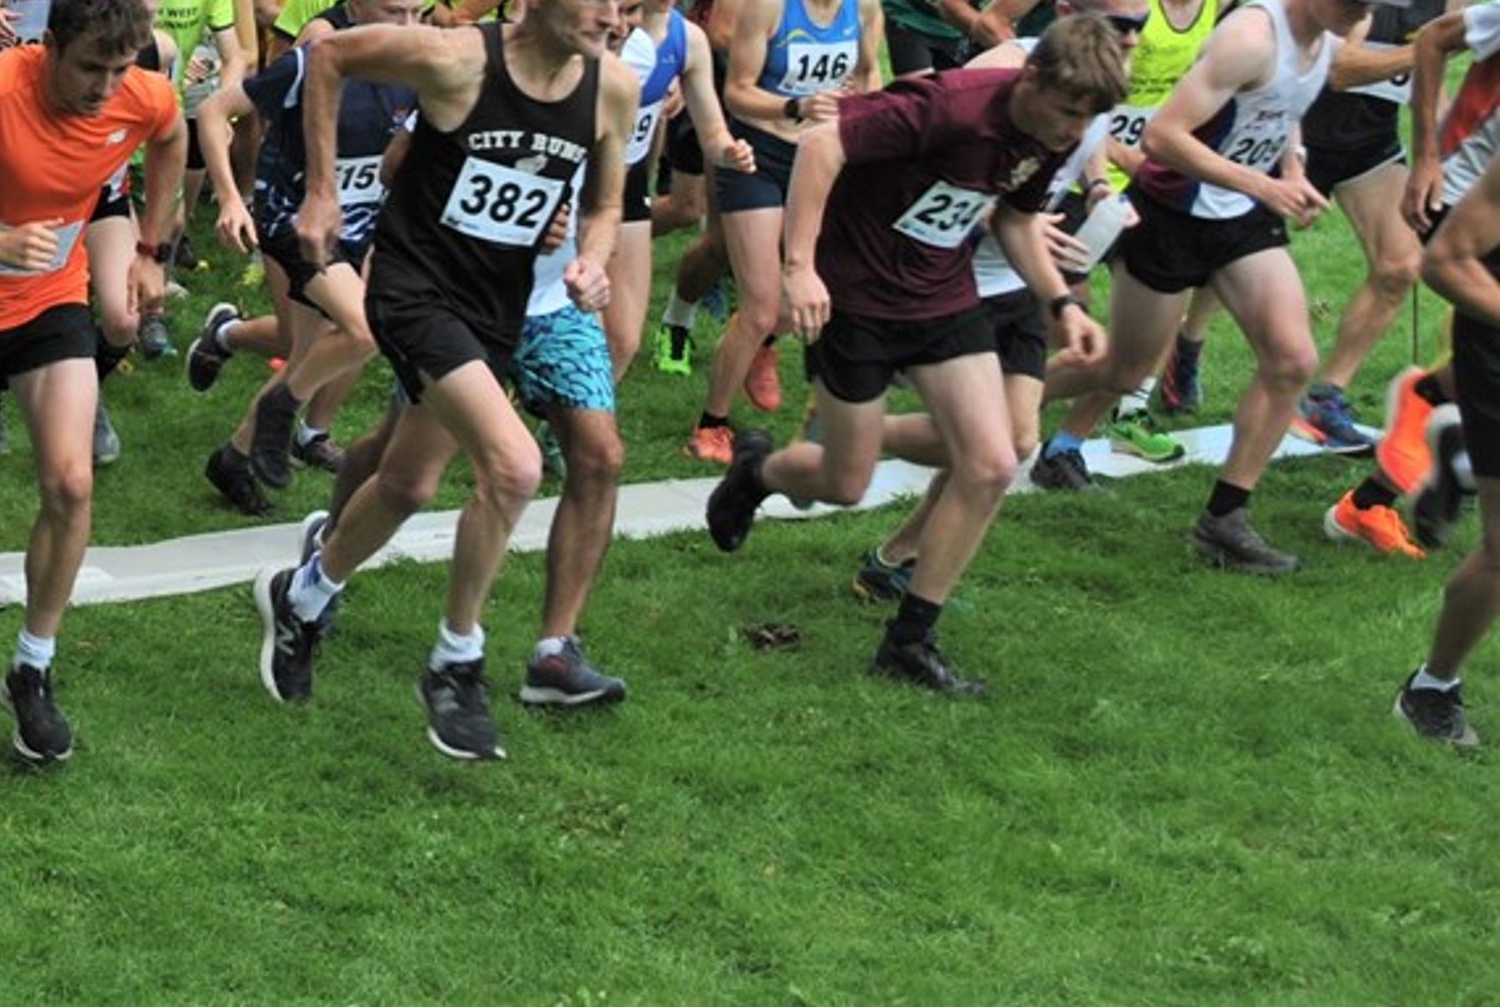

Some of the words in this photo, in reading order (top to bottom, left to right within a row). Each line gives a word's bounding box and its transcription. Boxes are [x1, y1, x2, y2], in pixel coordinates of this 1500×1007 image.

[796, 52, 848, 83] 146
[468, 130, 525, 151] CITY
[459, 174, 549, 229] 382
